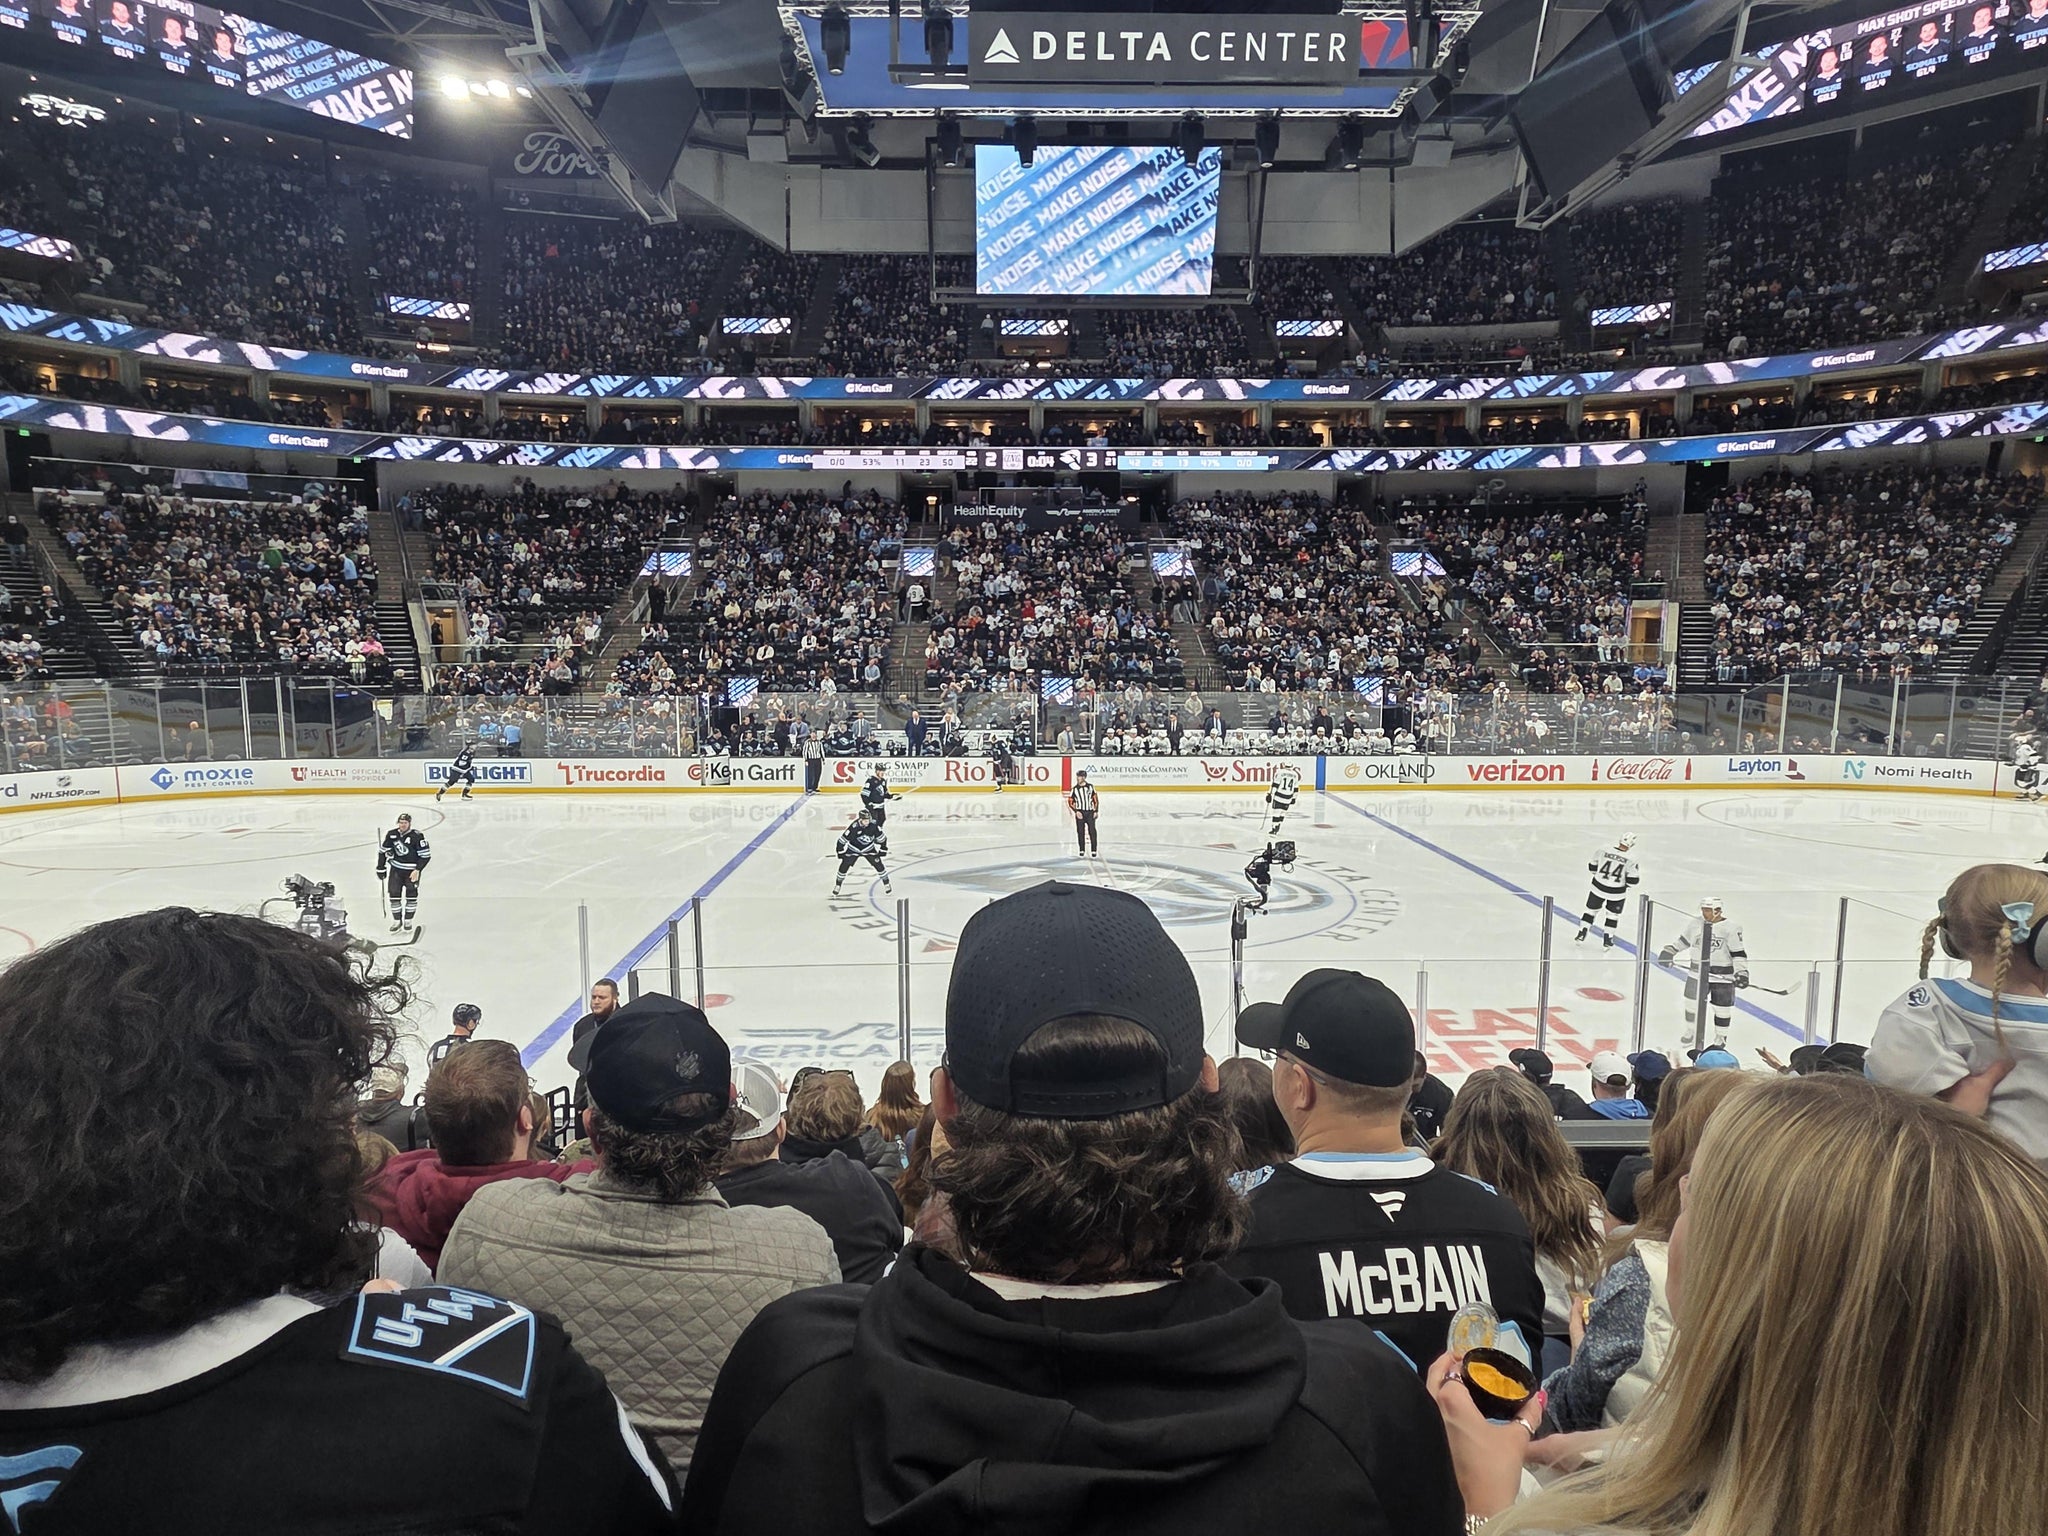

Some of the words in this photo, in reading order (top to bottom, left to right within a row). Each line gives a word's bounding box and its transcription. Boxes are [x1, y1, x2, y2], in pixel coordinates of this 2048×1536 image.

[1857, 19, 1886, 35] MAX
[1886, 10, 1921, 28] SHOT
[1032, 31, 1172, 61] DELTA
[1190, 32, 1346, 63] CENTER
[978, 161, 1026, 205] NOISE
[1030, 157, 1077, 201] MAKE
[986, 220, 1036, 262] NOISE
[1035, 185, 1083, 228] MAKE
[1079, 152, 1131, 197] NOISE
[993, 249, 1043, 292] NOISE
[1040, 216, 1090, 258] MAKE
[1086, 184, 1137, 228] NOISE
[1051, 248, 1100, 289] MAKE
[1097, 215, 1147, 257] NOISE
[1136, 249, 1186, 289] NOISE
[1824, 354, 1845, 367] Ken
[1845, 349, 1876, 364] Garff
[361, 363, 382, 377] Ken
[383, 365, 409, 379] Garff
[855, 383, 870, 394] Ken
[870, 383, 893, 394] Garff
[1311, 384, 1329, 395] Ken
[1329, 383, 1350, 395] Garff
[280, 433, 302, 447] Ken
[302, 434, 329, 449] Garff
[1727, 439, 1749, 452] Ken
[1749, 437, 1776, 451] Garff
[829, 458, 845, 466] 0/0
[862, 458, 882, 466] 53%
[895, 458, 905, 466] 11
[919, 458, 931, 466] 23
[942, 458, 954, 466] 50
[985, 451, 998, 467] 2
[1027, 456, 1055, 467] 0:04
[1086, 452, 1098, 467] 3
[1128, 459, 1141, 467] 42
[1200, 459, 1220, 467] 47%
[1236, 459, 1252, 468] 0/0
[954, 505, 1027, 519] HealthEquity
[184, 767, 254, 781] moxie
[310, 768, 347, 778] HEALTH
[473, 766, 527, 780] LIGHT
[574, 765, 665, 782] Trucordia
[711, 762, 743, 780] Ken
[748, 763, 796, 781] Garff
[894, 761, 930, 770] SWAPP
[945, 760, 985, 783] Rio
[1365, 763, 1435, 779] OKLAND
[1467, 759, 1564, 781] verizon
[1728, 758, 1781, 775] Layton
[1875, 765, 1914, 778] Nomi
[1919, 767, 1973, 781] Health
[1282, 777, 1294, 791] 14
[404, 836, 411, 844] A
[1599, 860, 1625, 883] 44
[1314, 888, 1401, 942] CENTER
[1319, 1245, 1494, 1318] McBAIN
[372, 1291, 496, 1348] UTAH
